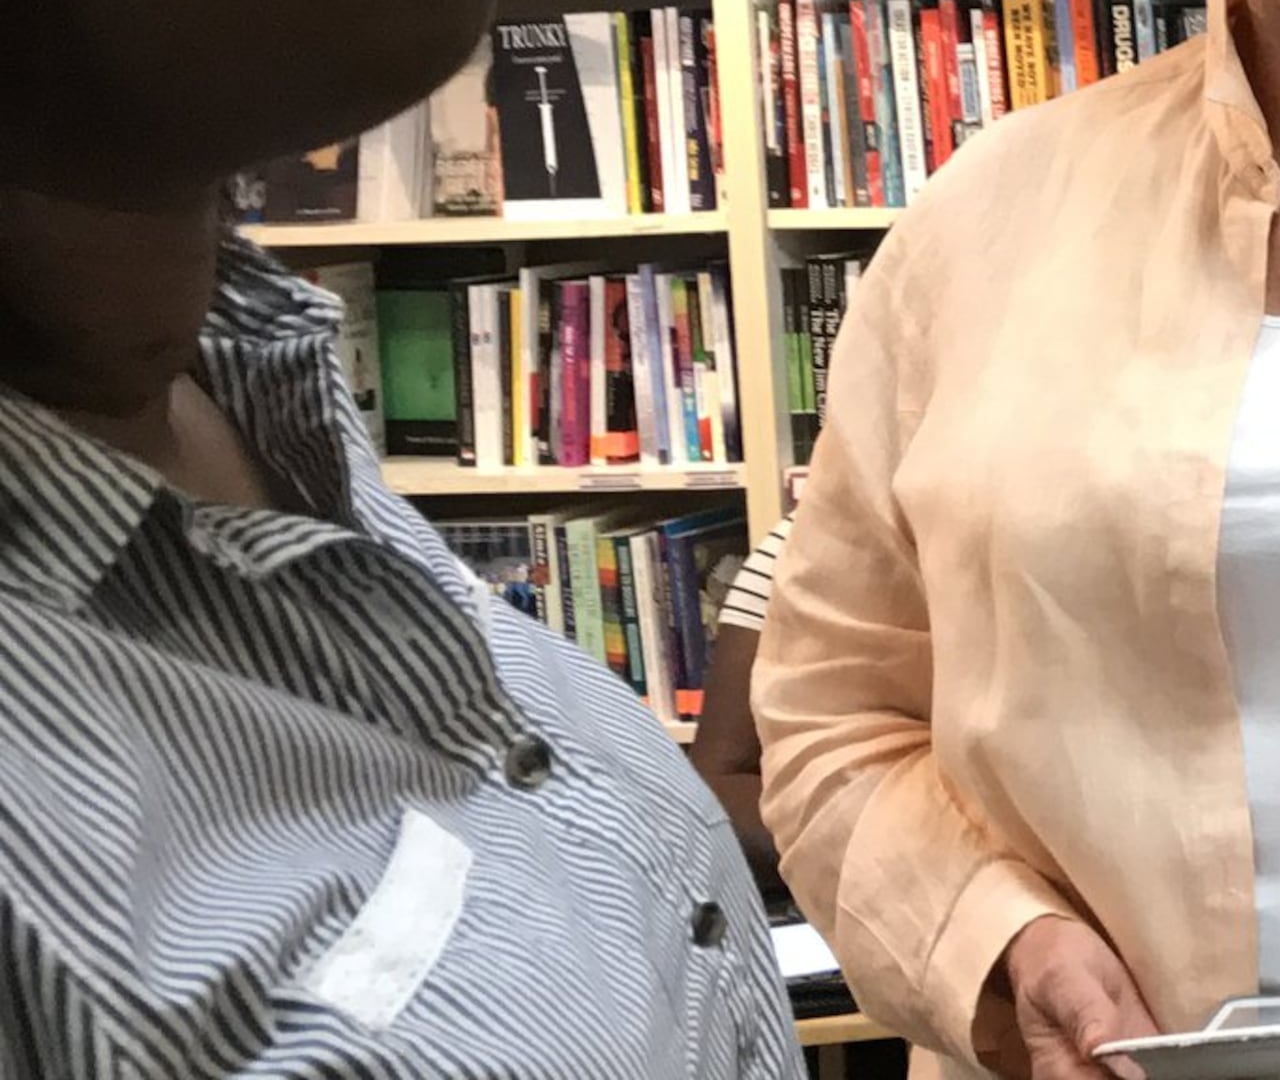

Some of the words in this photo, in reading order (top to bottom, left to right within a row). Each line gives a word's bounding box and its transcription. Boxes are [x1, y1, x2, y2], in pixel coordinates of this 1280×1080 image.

[1024, 26, 1037, 58] HAVE
[1112, 4, 1135, 74] DRUGS
[1015, 45, 1027, 89] MOVED
[811, 307, 825, 335] The
[812, 336, 827, 366] New
[813, 368, 827, 391] Jim
